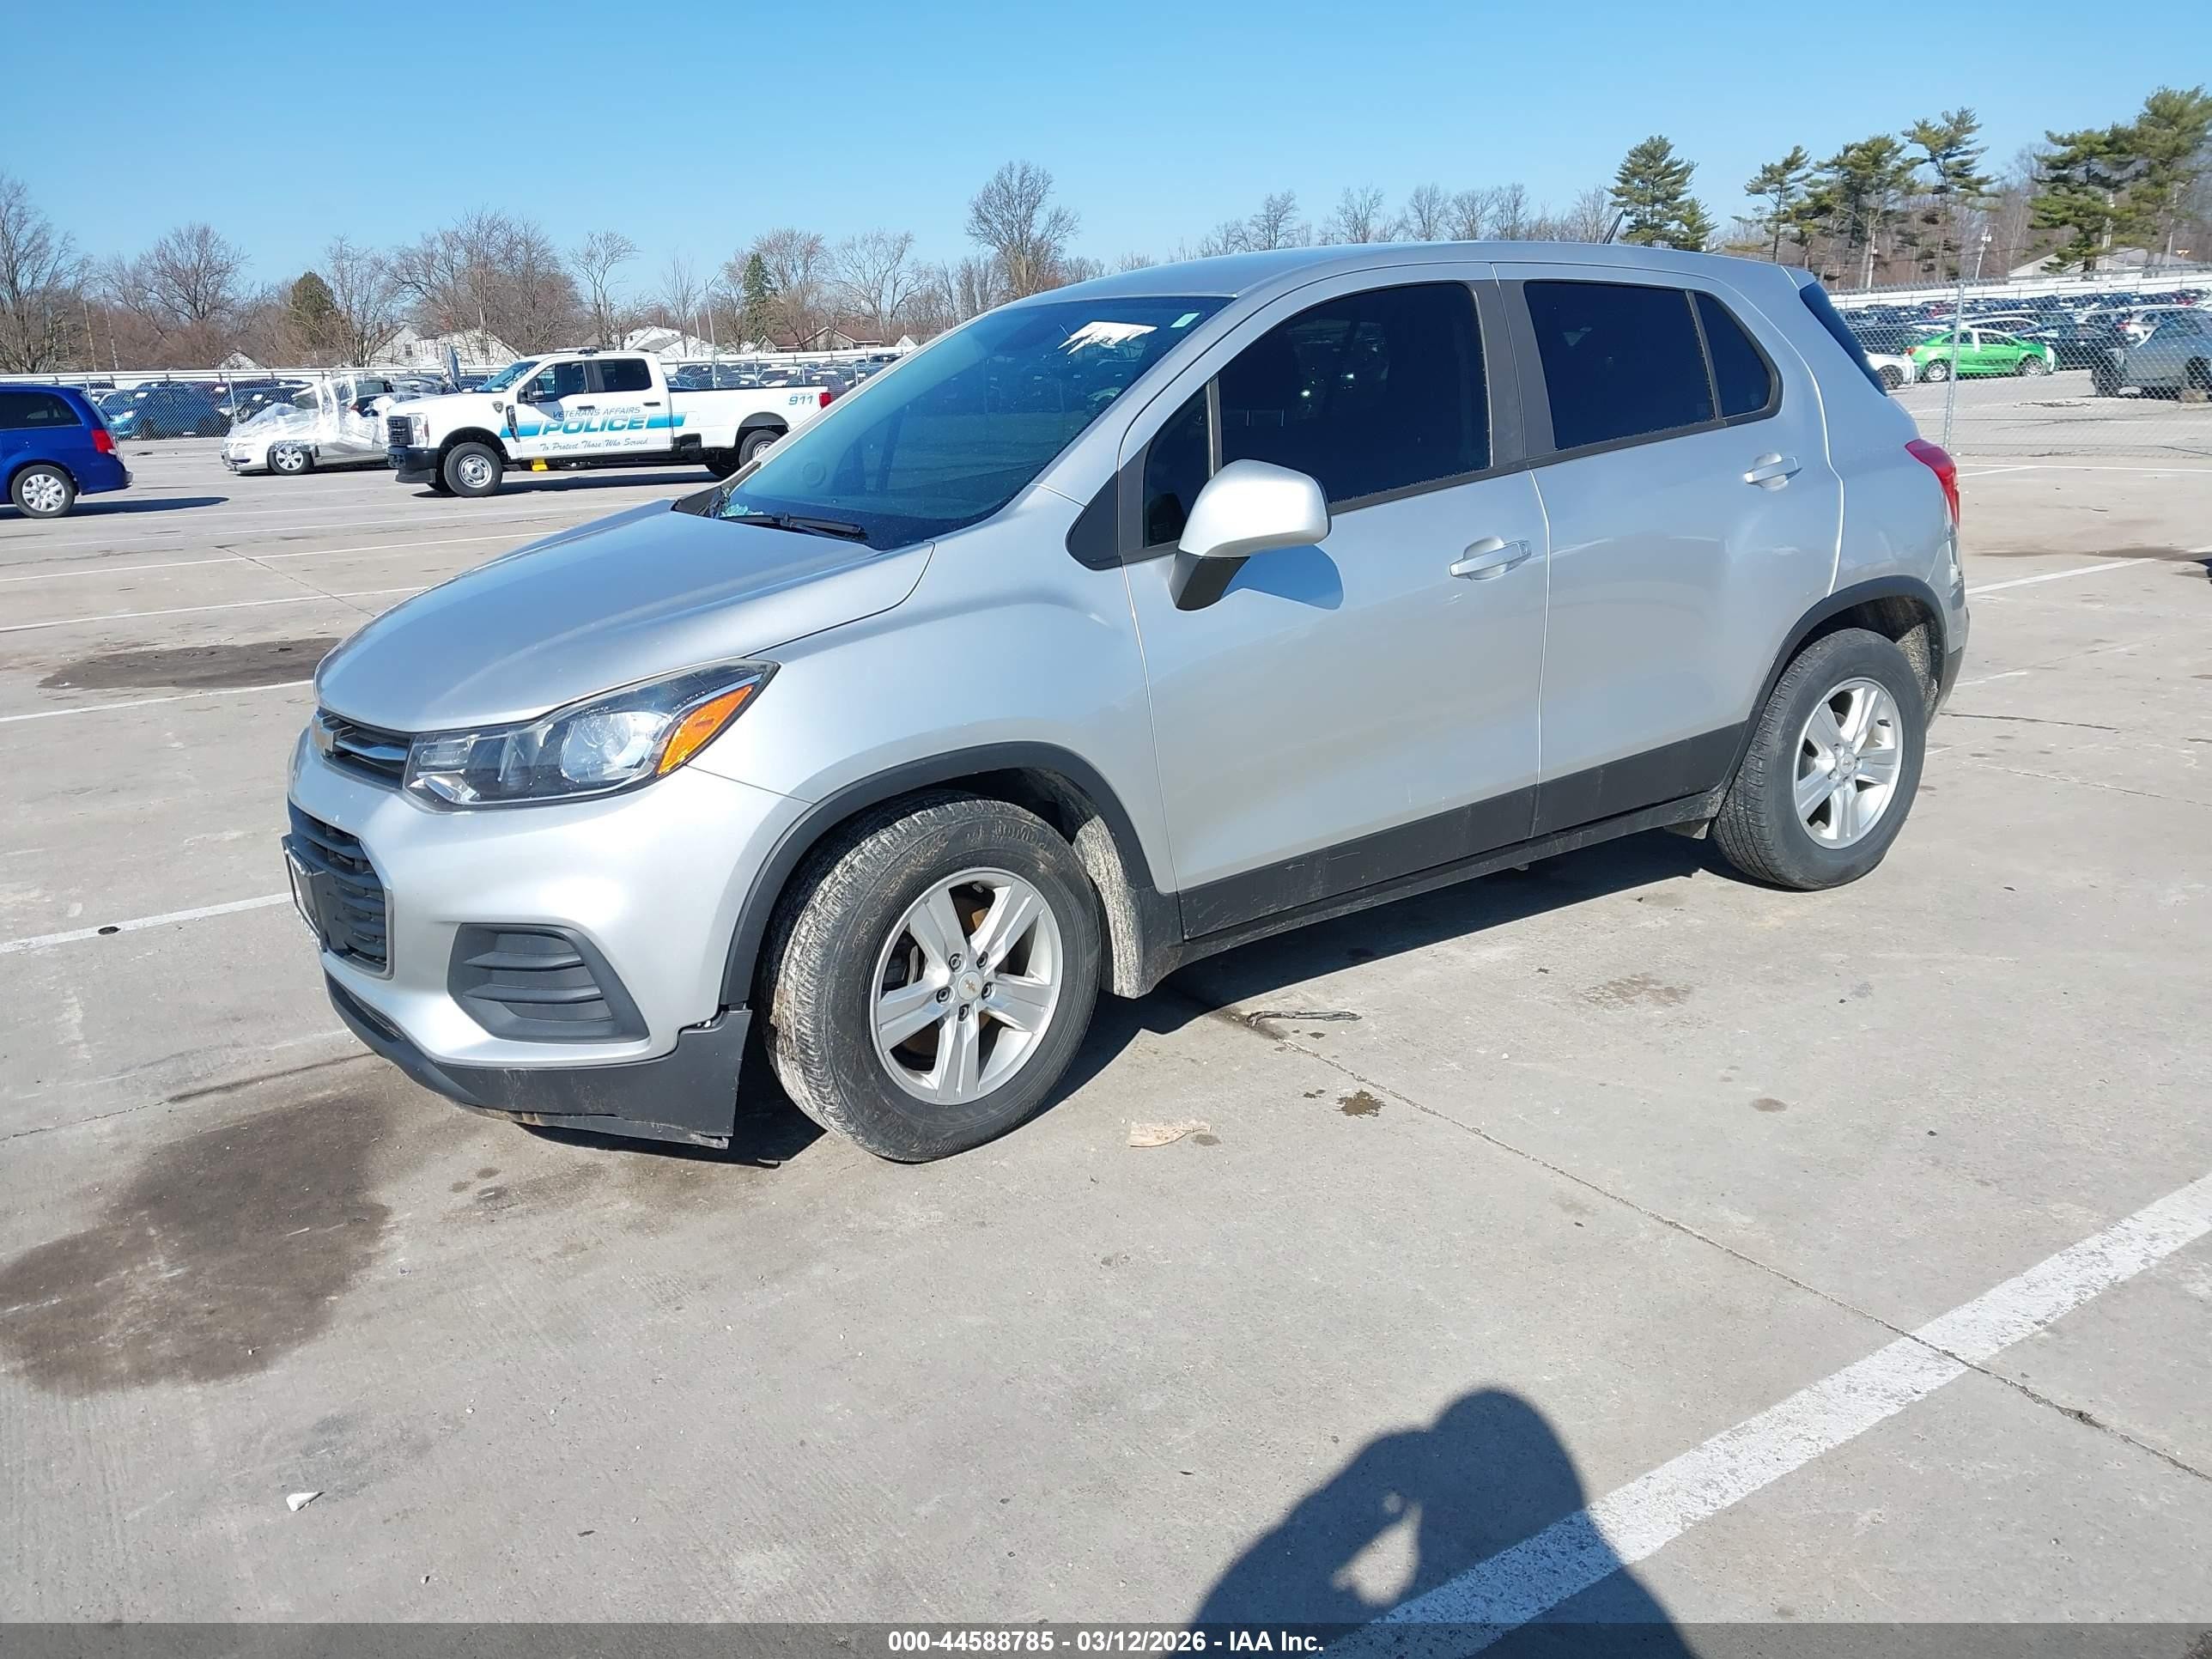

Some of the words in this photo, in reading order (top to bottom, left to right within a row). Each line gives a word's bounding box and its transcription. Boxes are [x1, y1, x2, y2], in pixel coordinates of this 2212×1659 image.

[788, 395, 813, 405] 911
[552, 409, 600, 418] VETERANS
[603, 406, 641, 416] AFFAIRS
[542, 415, 647, 435] POLICE
[552, 441, 579, 451] Protect
[580, 440, 602, 448] Those
[605, 439, 621, 447] Who
[623, 437, 649, 447] Served
